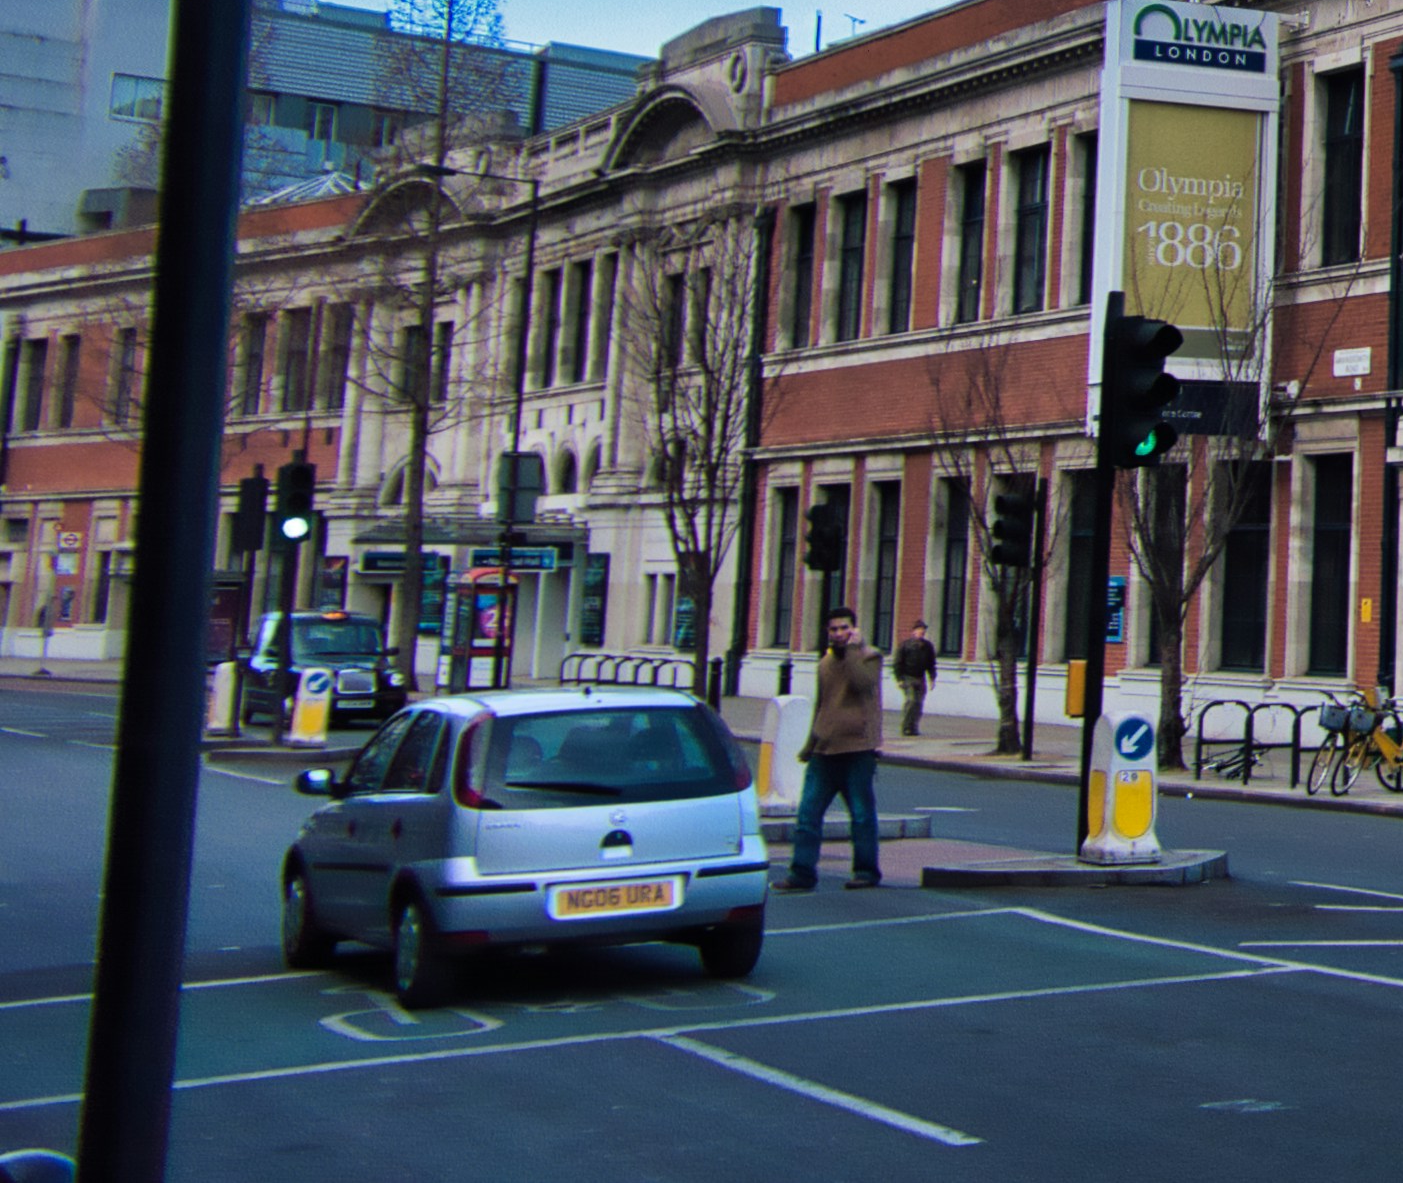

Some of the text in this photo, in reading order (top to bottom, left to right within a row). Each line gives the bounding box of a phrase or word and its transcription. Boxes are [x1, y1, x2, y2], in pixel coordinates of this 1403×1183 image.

[1133, 3, 1267, 50] OLYMPIA
[1154, 44, 1247, 65] LONDON
[1138, 167, 1243, 205] Olympia
[1137, 221, 1242, 269] 1886
[567, 883, 665, 910] NG06 URA
